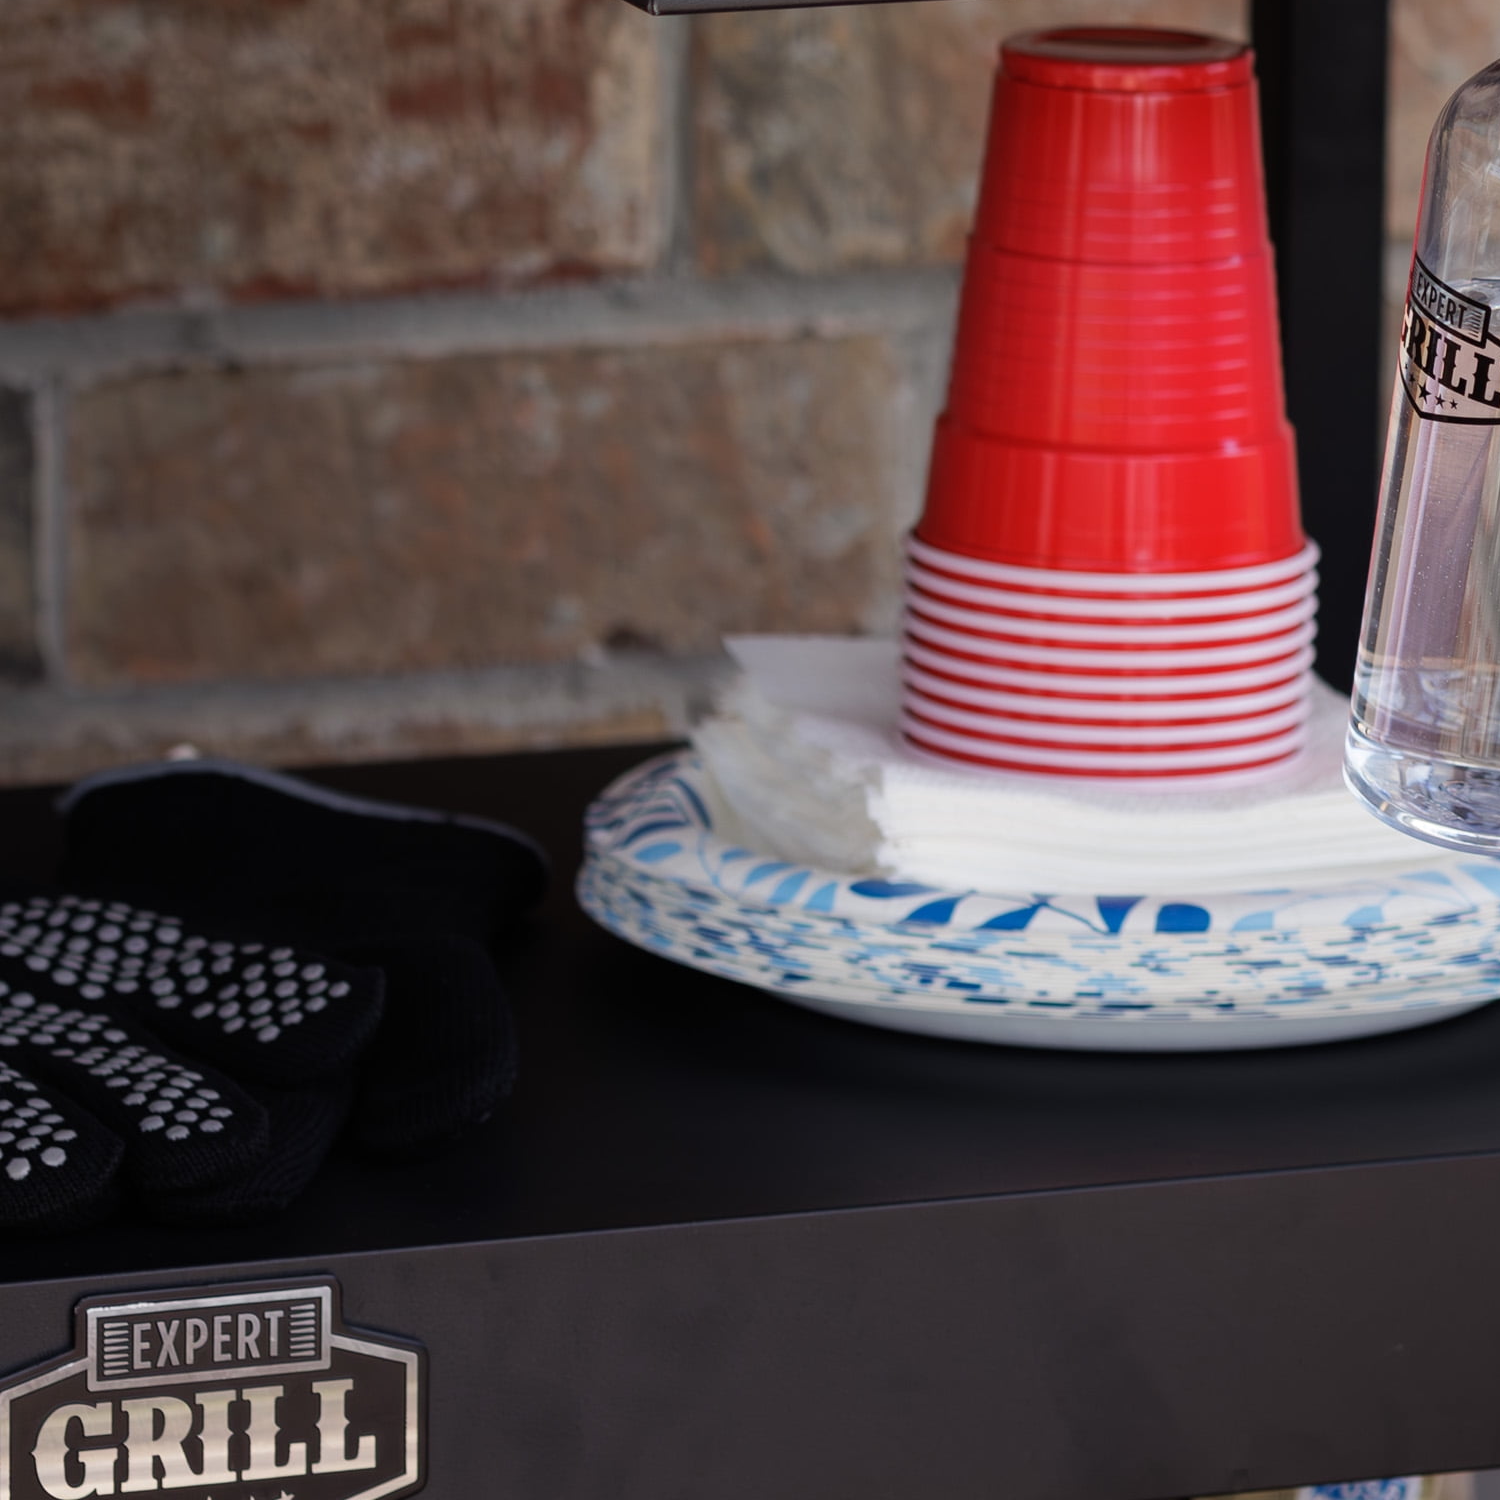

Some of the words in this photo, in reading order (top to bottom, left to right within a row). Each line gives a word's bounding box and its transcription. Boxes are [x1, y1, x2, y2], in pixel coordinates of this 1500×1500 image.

[1417, 272, 1467, 329] EXPERT
[133, 1309, 285, 1370] EXPERT
[30, 1378, 377, 1500] GRILL
